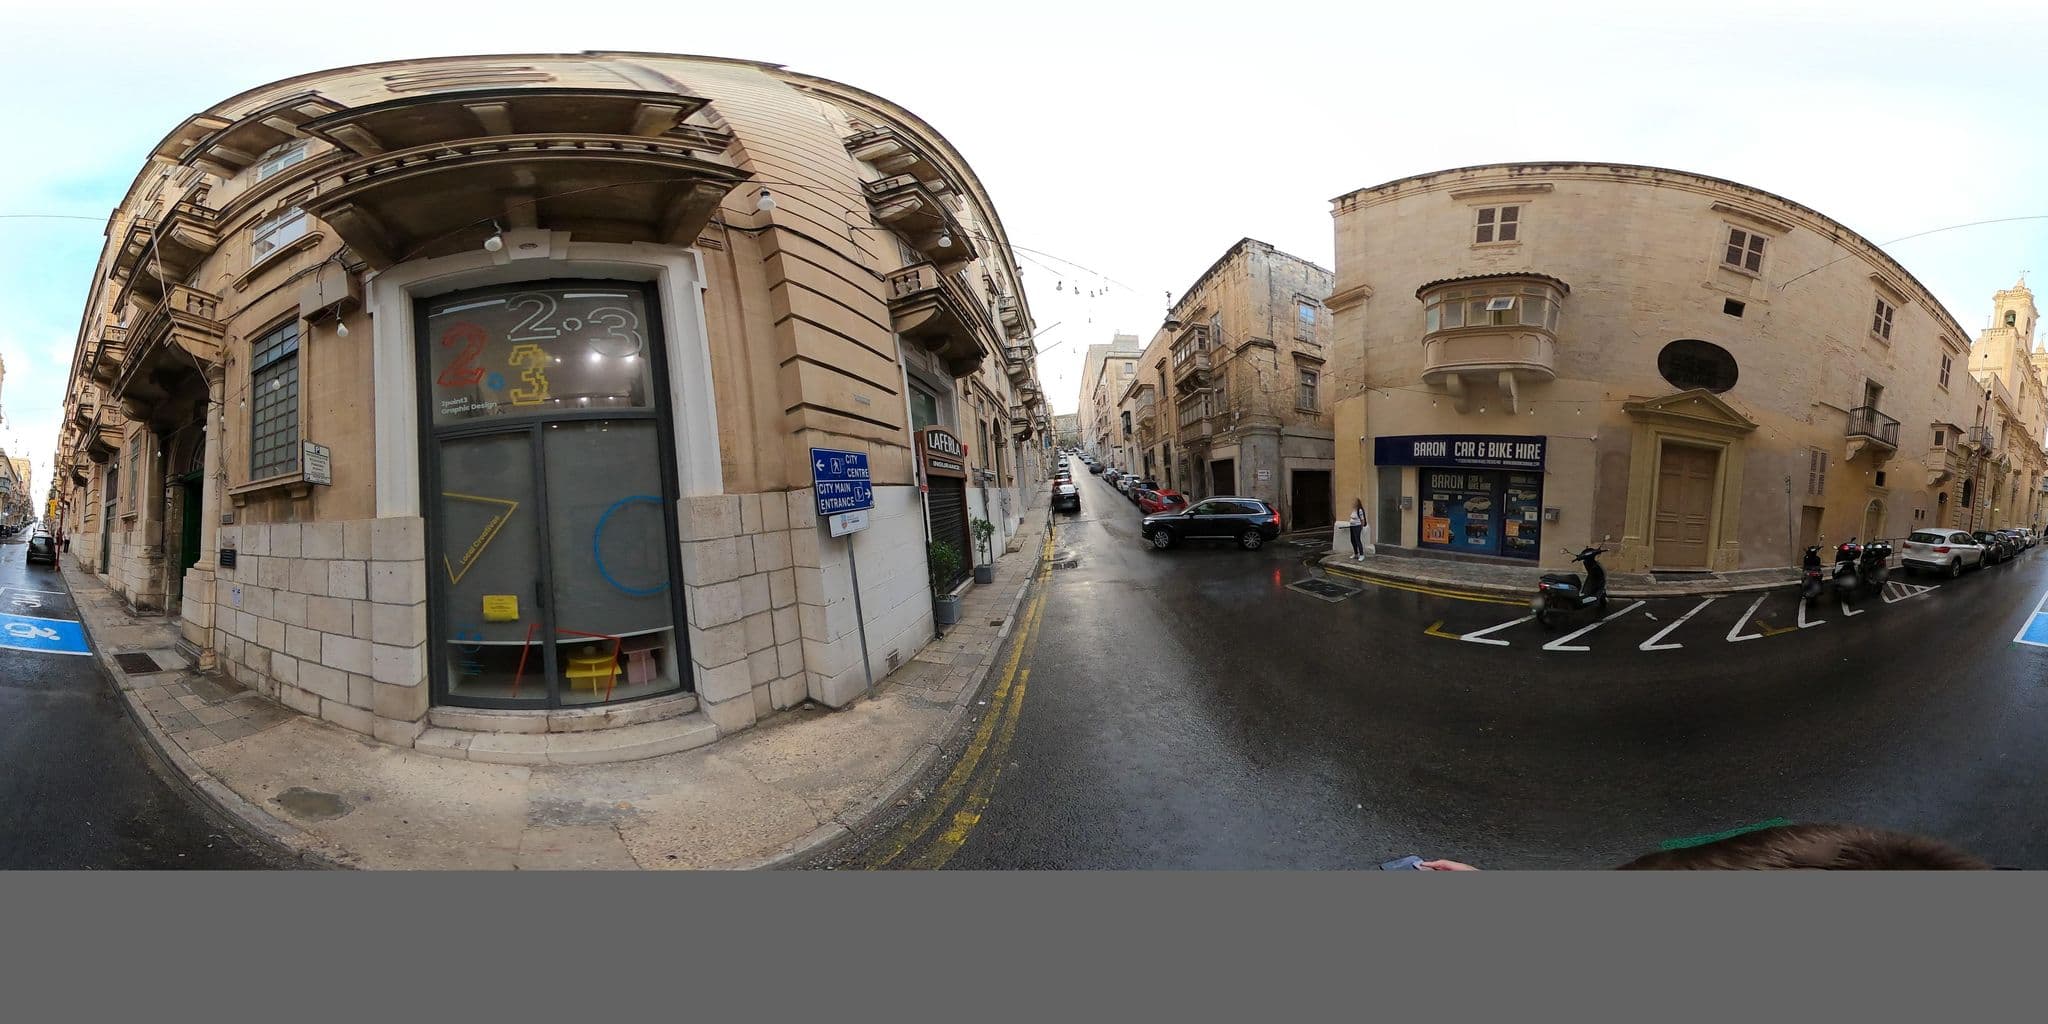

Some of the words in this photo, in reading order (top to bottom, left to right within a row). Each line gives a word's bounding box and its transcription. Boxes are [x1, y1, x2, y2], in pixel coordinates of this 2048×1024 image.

[441, 404, 470, 415] Graphic
[471, 401, 497, 410] Design
[928, 433, 961, 456] LAFERLA
[1413, 442, 1446, 457] BARON
[1454, 442, 1475, 457] CAR
[1478, 442, 1485, 457] &
[1488, 443, 1512, 458] BIKE
[1516, 443, 1541, 460] HIRE
[845, 454, 858, 464] CITY
[846, 467, 869, 478] CENTRE
[818, 483, 834, 495] CITY
[834, 482, 851, 493] MAIN
[1431, 475, 1464, 489] BARON
[820, 496, 855, 510] ENTRANCE
[460, 547, 474, 564] Local
